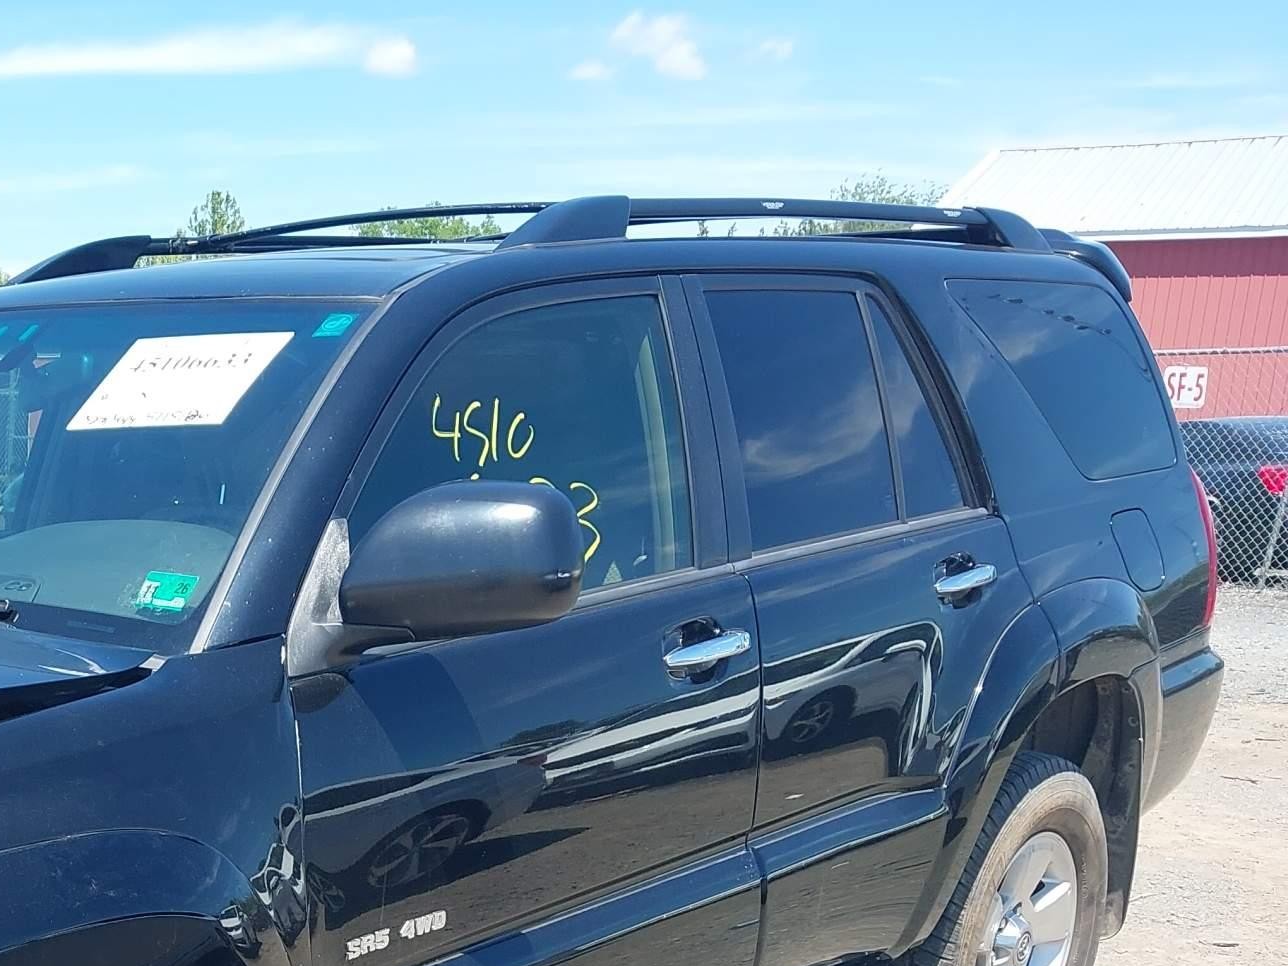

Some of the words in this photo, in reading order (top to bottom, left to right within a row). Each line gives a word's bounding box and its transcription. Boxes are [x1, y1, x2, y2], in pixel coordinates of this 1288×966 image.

[1167, 372, 1205, 402] SF-5
[173, 581, 191, 595] 26
[346, 927, 391, 961] SR5
[399, 910, 447, 940] 4WD
